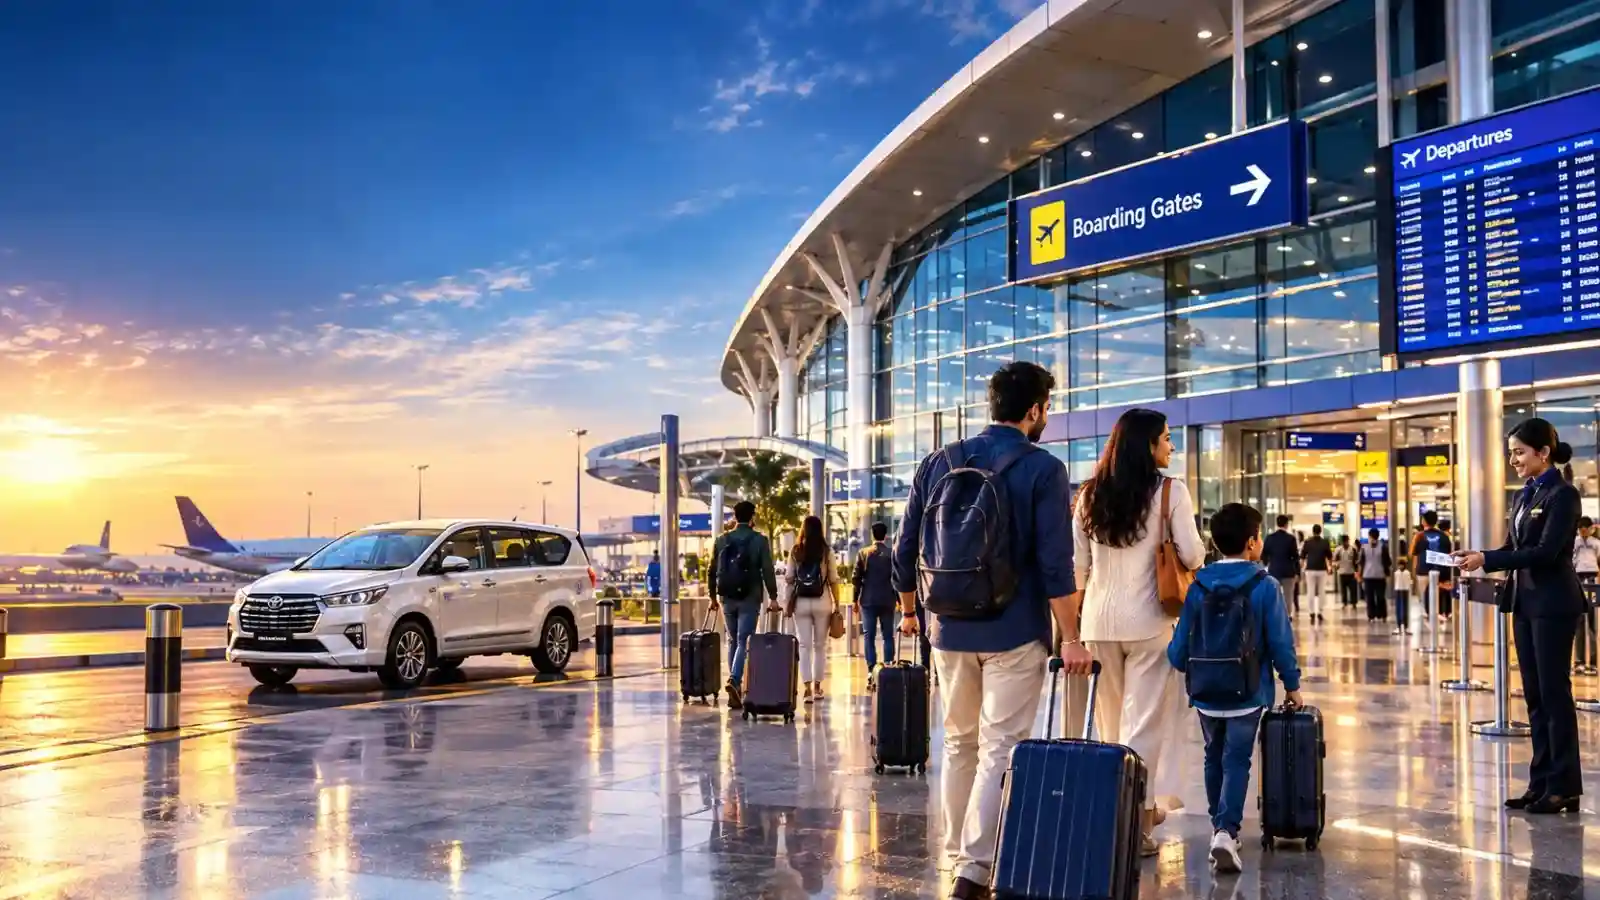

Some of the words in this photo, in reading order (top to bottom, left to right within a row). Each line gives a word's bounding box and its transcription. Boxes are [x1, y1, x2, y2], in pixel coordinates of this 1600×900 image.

[1426, 127, 1513, 161] Departures
[1072, 206, 1146, 239] Boarding
[1150, 192, 1203, 219] Gates
